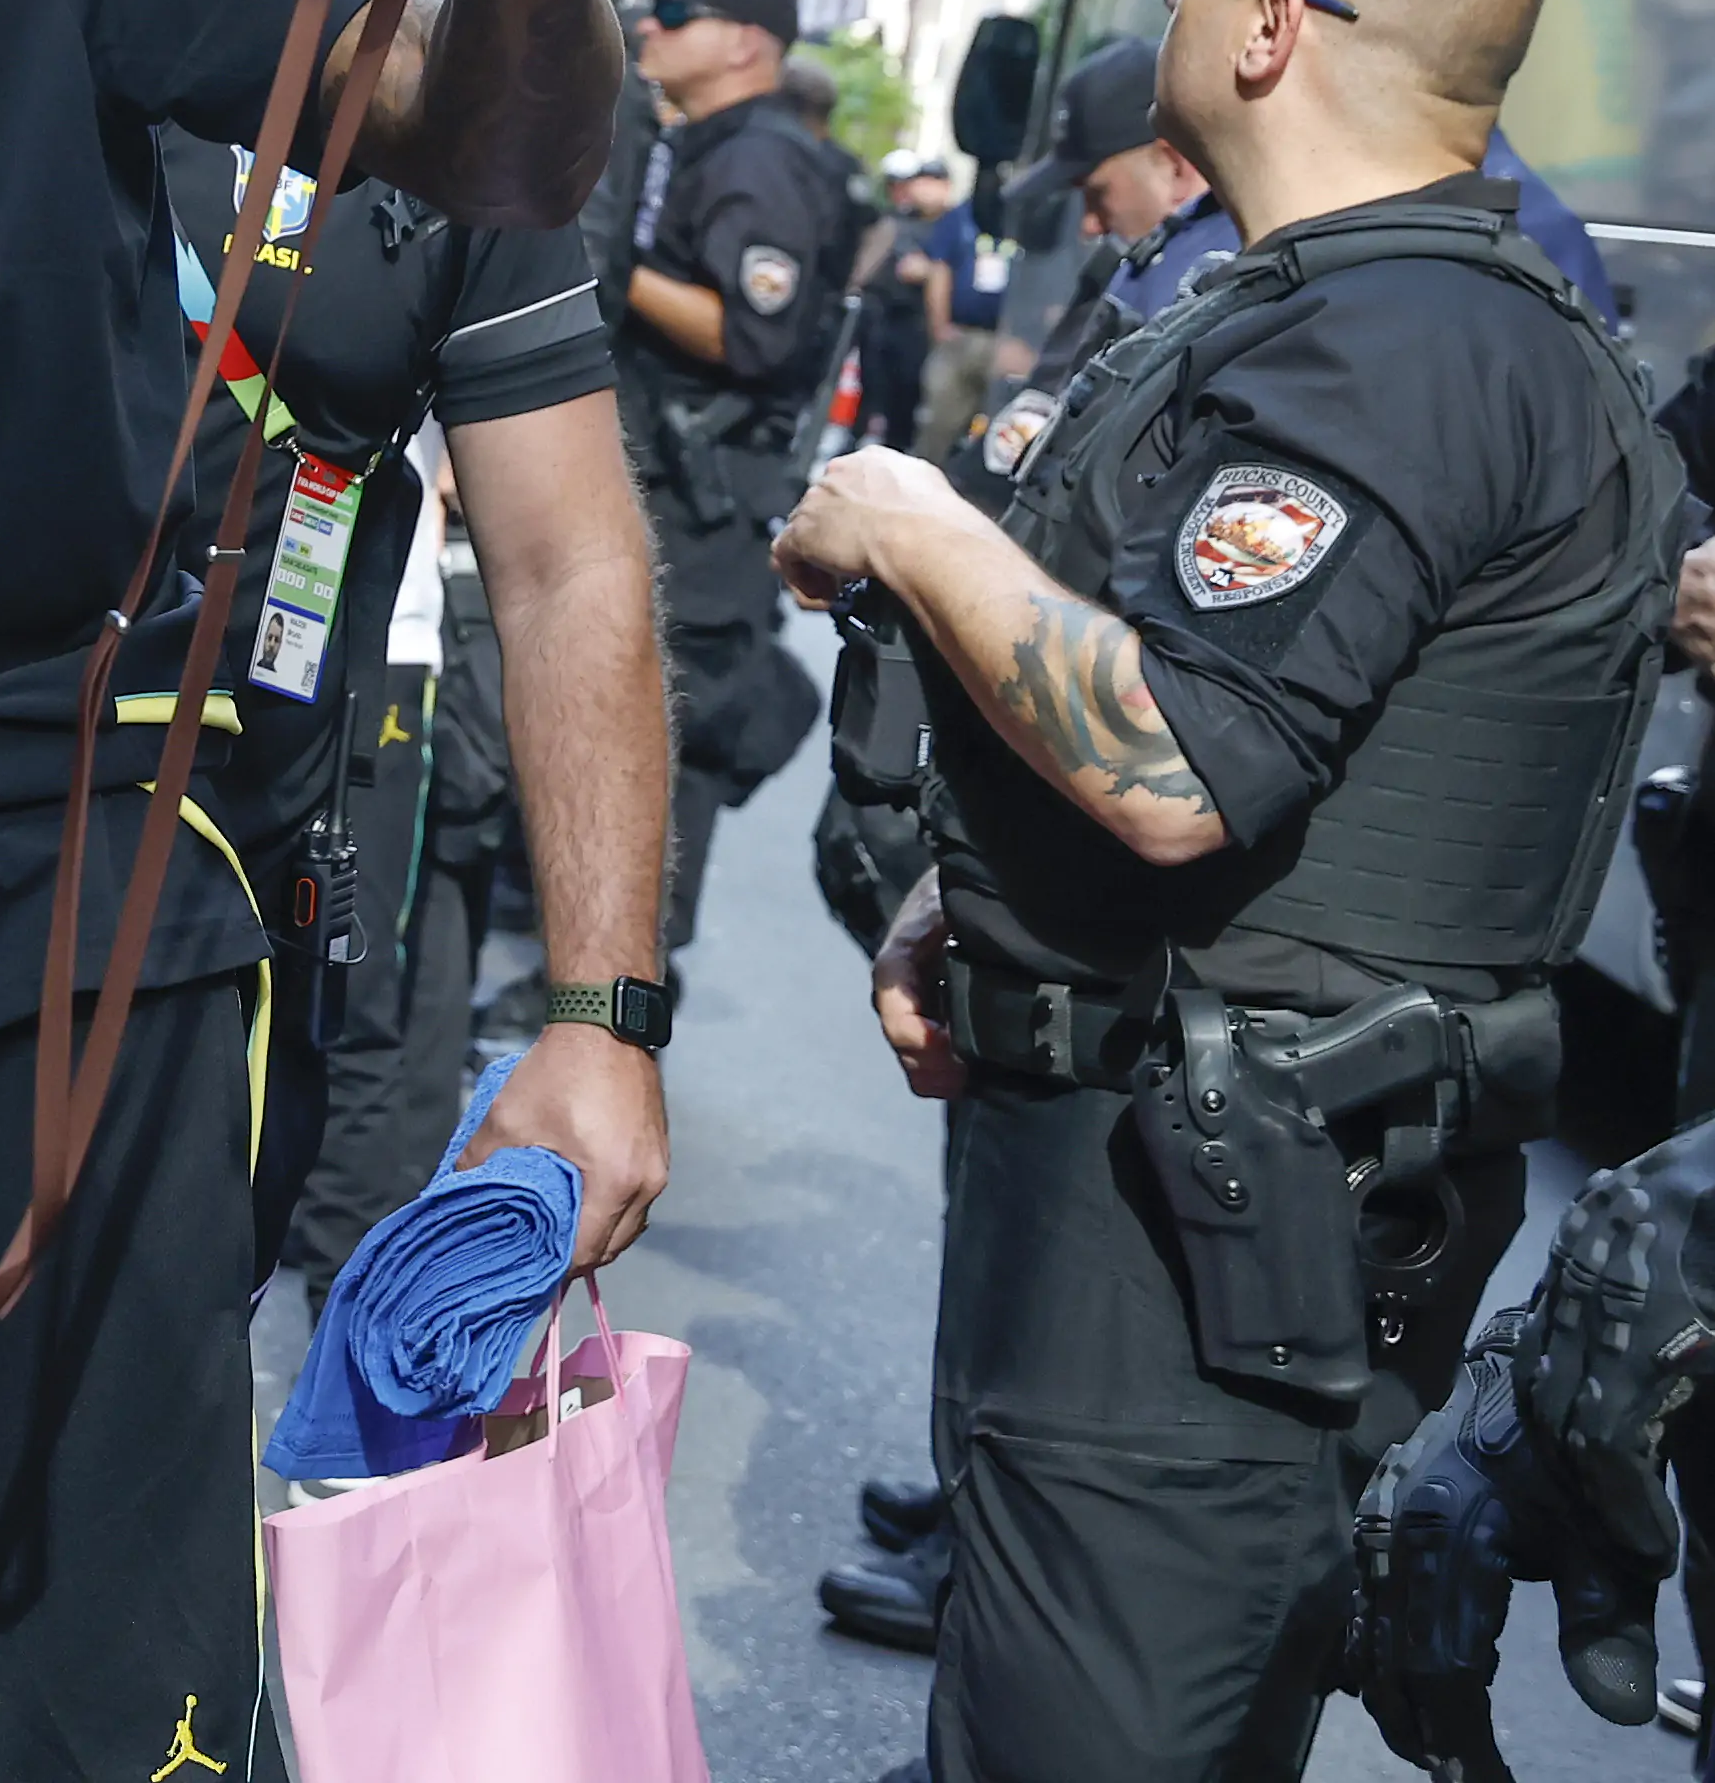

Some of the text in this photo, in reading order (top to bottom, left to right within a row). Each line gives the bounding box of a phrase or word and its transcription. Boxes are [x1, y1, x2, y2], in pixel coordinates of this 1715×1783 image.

[1216, 468, 1345, 529] BUCKS COUNTY
[1180, 542, 1207, 597] INCIDENT
[1212, 574, 1294, 604] RESPONSE
